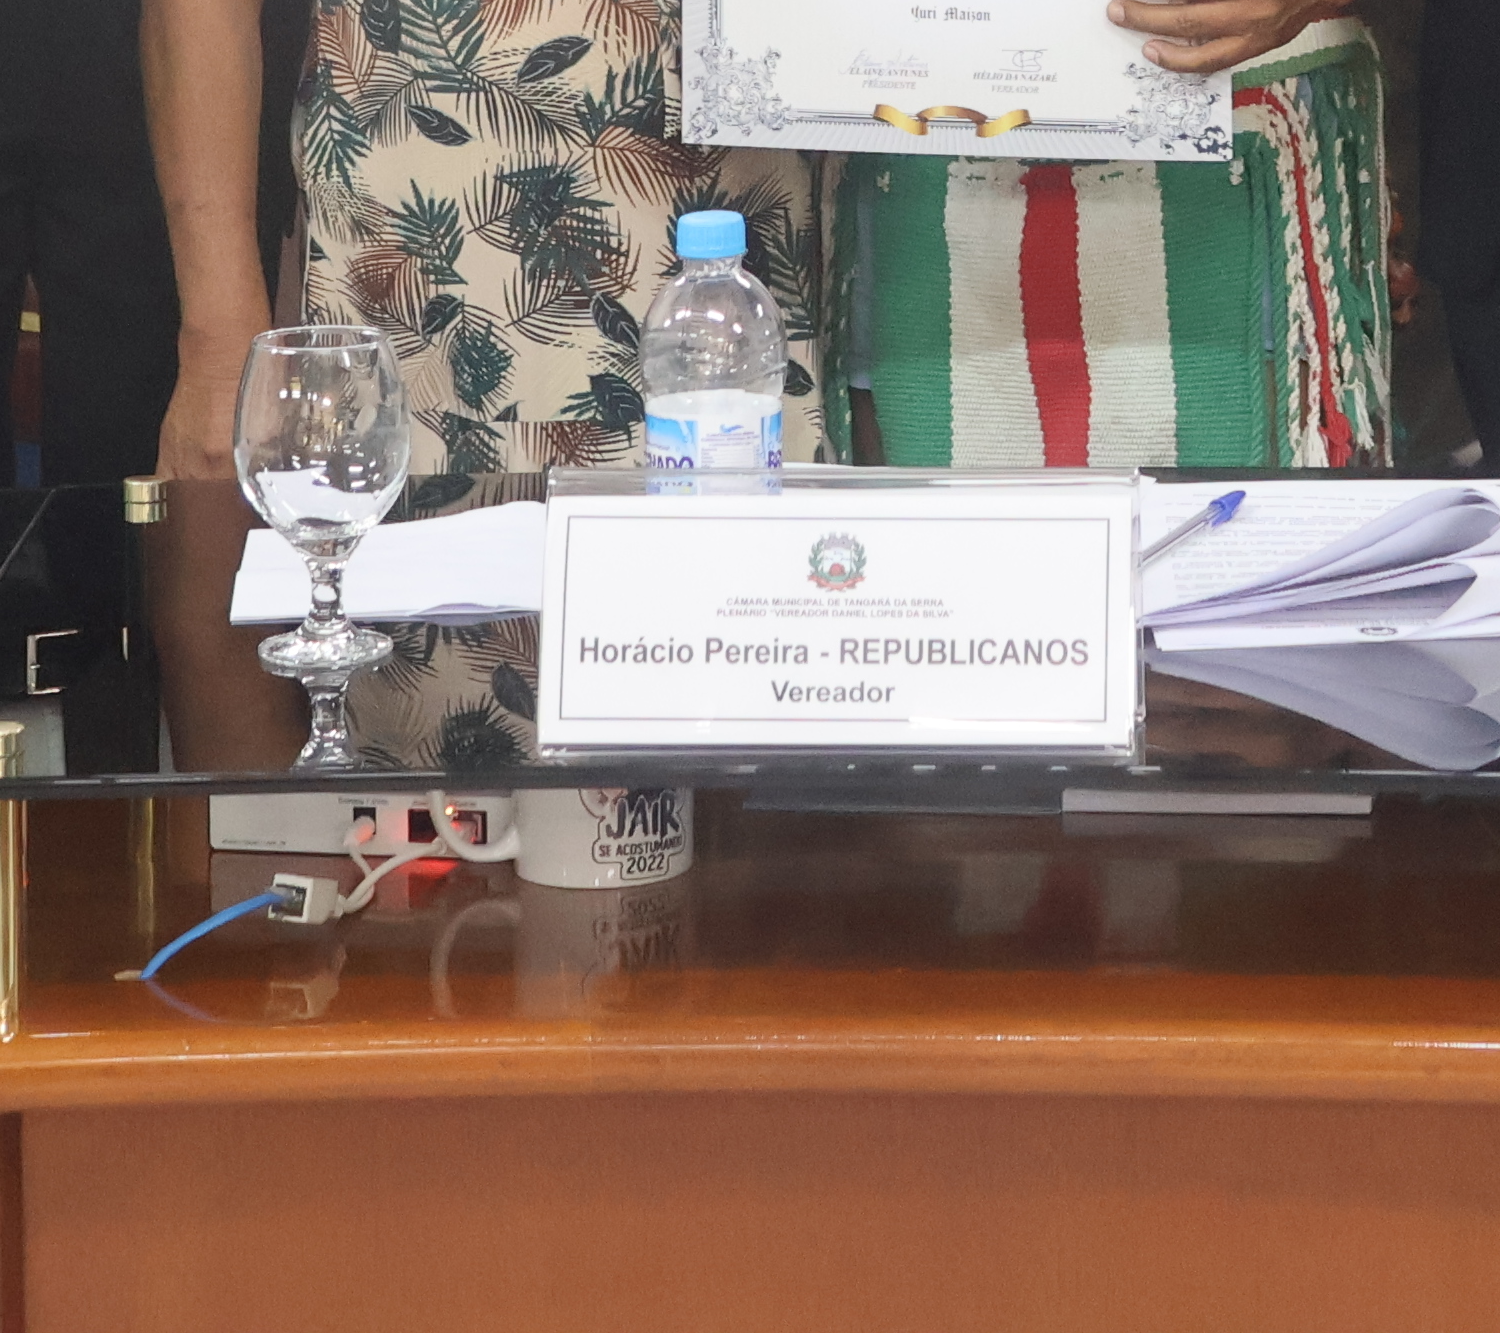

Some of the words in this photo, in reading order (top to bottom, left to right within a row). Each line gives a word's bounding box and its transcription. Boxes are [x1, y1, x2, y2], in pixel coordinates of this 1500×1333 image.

[944, 6, 991, 22] Maizon
[726, 596, 769, 607] CÂMARA
[772, 598, 824, 607] MUNICIPAL
[827, 598, 840, 607] DE
[844, 596, 891, 607] TANGARÁ
[894, 598, 908, 607] DA
[910, 598, 944, 607] SERRA
[716, 607, 767, 617] PLENÁRIO
[831, 609, 868, 618] DANIEL
[870, 609, 904, 618] LOPES
[906, 609, 920, 618] DA
[579, 636, 695, 665] Horácio
[704, 637, 810, 665] Pereira
[839, 638, 1090, 666] REPUBLICANOS
[770, 680, 896, 704] Vereador
[605, 792, 680, 840] JAIR
[599, 844, 611, 857] SE
[627, 853, 665, 874] 2022
